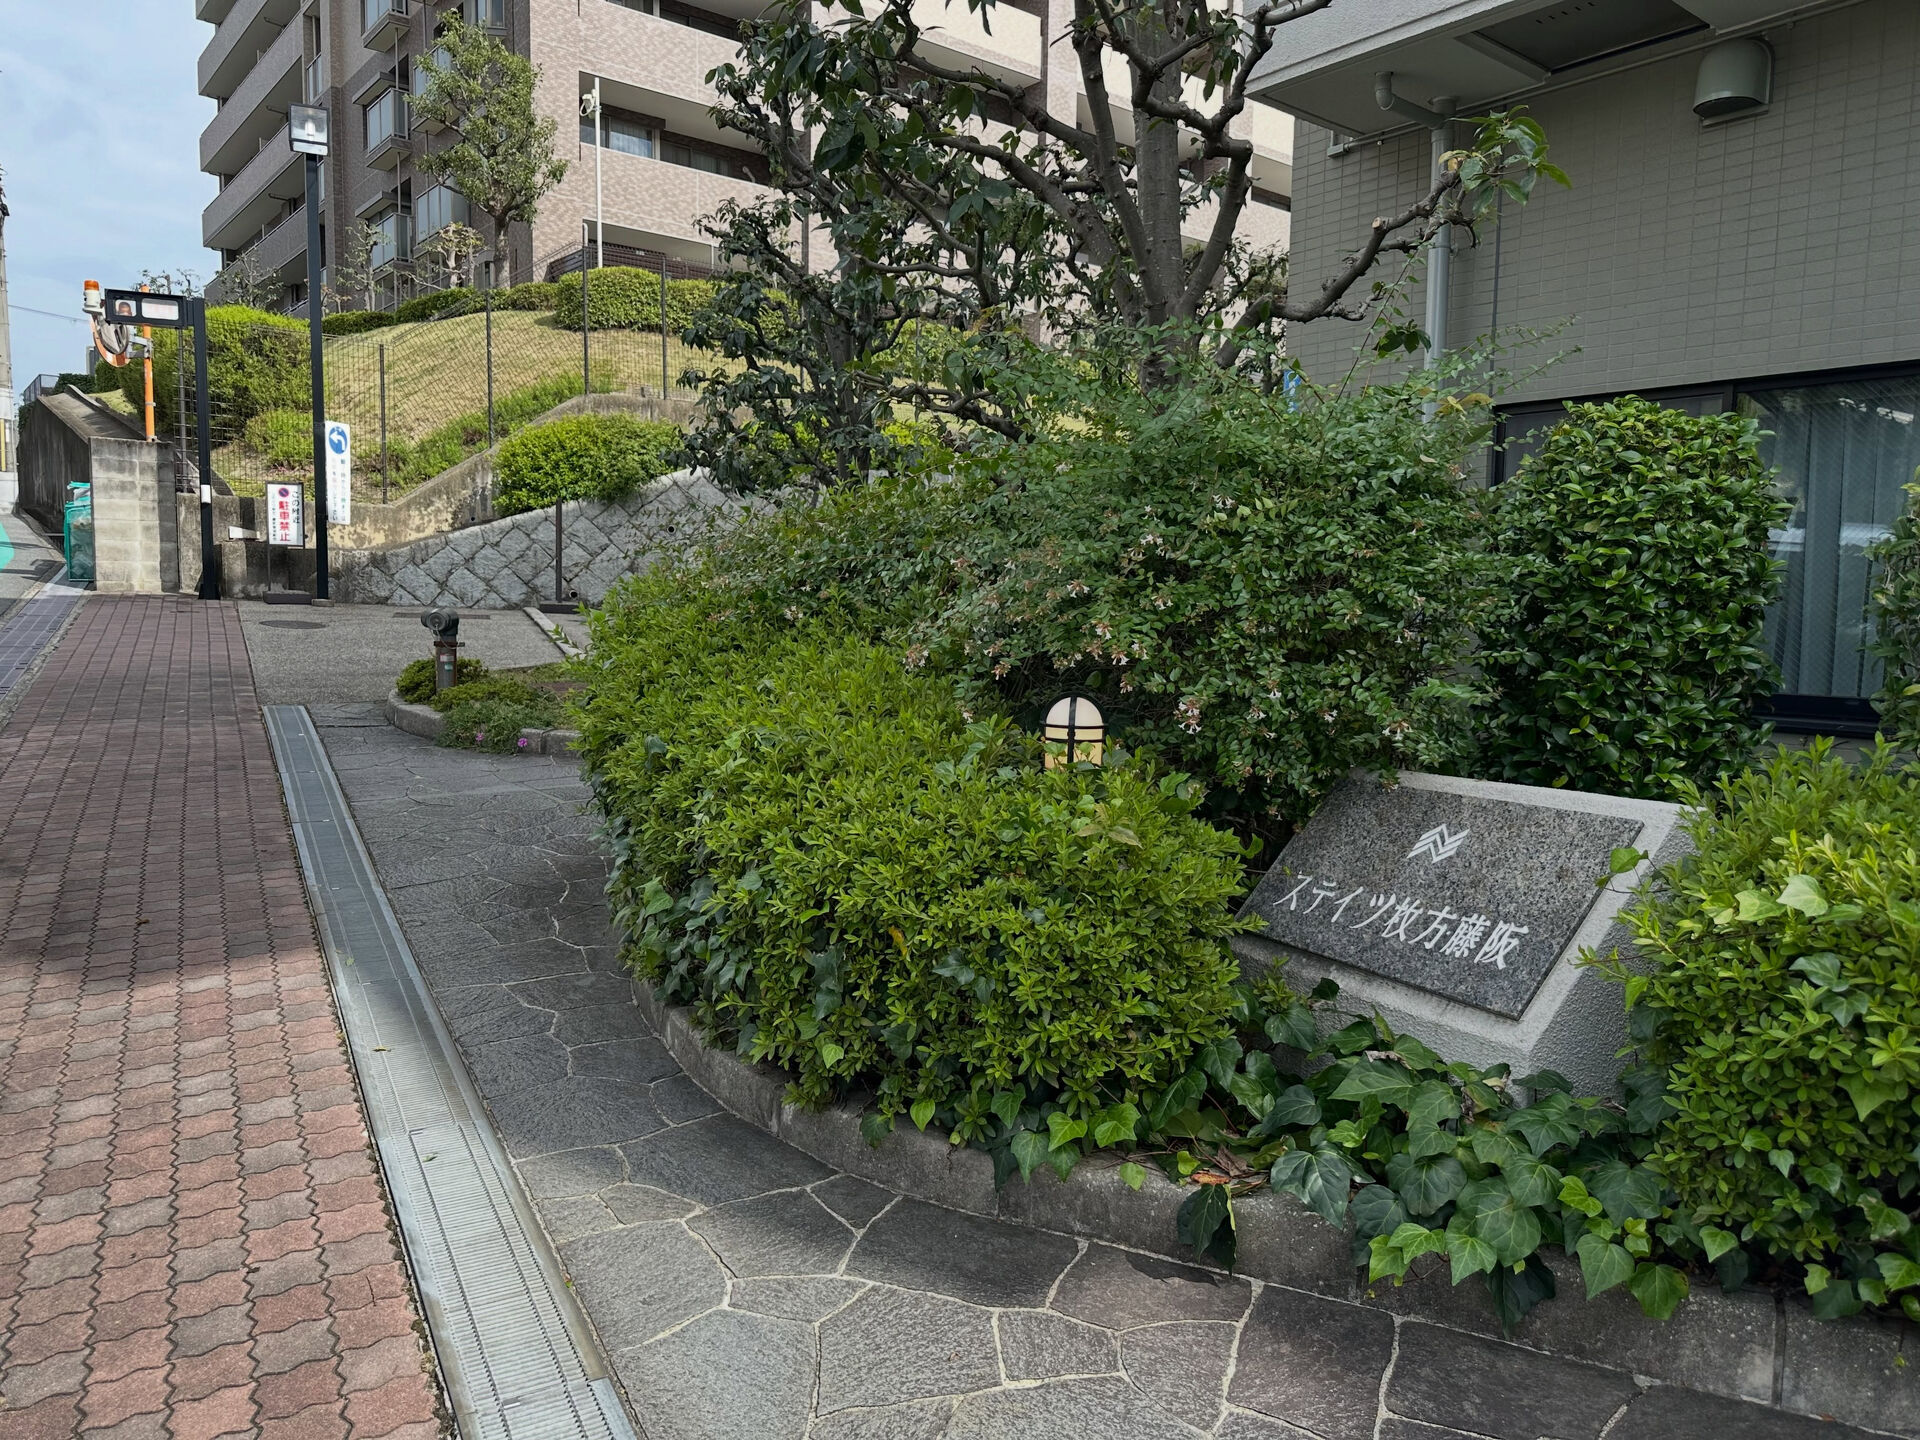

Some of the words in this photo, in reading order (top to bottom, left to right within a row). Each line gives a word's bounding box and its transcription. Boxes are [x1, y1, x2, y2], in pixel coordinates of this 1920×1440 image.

[278, 500, 291, 542] 駐車禁止
[1273, 871, 1529, 970] ステイツ枚方藤阪
